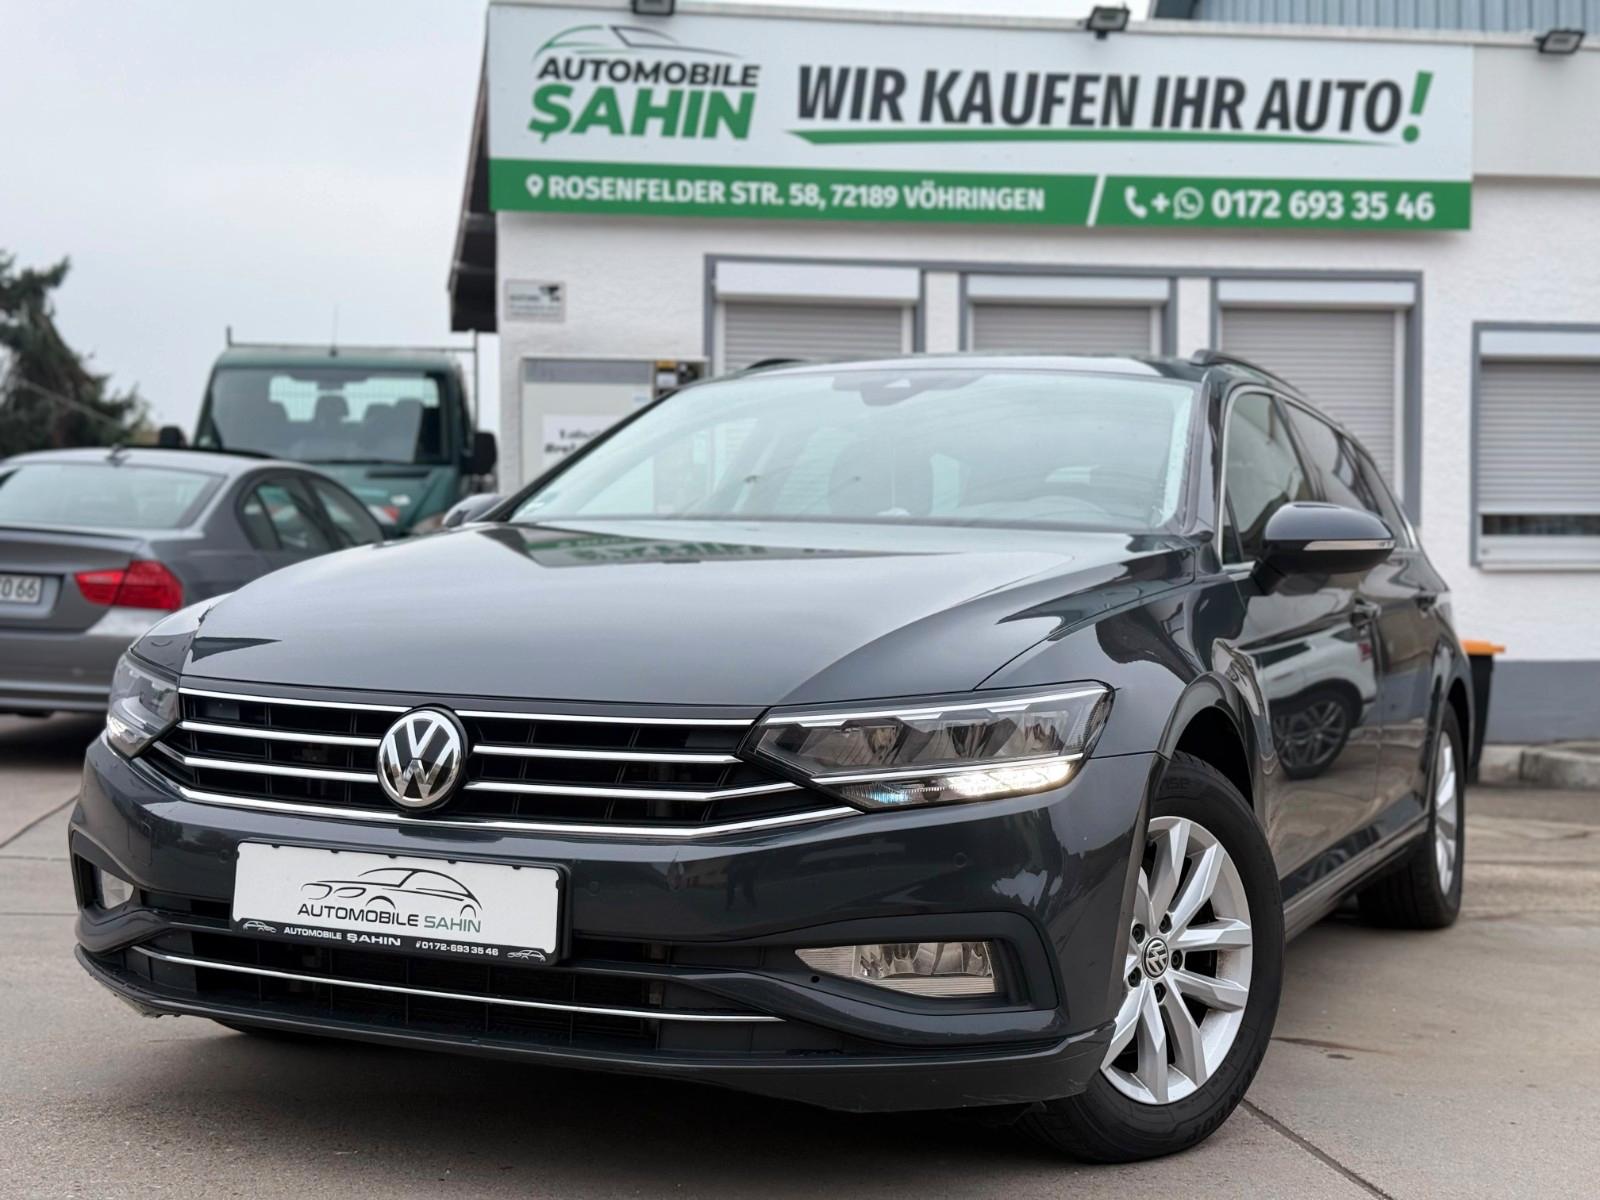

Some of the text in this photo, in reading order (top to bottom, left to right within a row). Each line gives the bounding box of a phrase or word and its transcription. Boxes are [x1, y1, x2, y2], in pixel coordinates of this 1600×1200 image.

[537, 57, 760, 88] AUTOMOBILE
[527, 83, 757, 142] ŞAHIN
[797, 65, 1433, 143] WIR KAUFEN IHR AUTO!
[548, 175, 1045, 212] ROSENFELDER STR. 58, 72189 VÖHRINGEN
[1211, 187, 1436, 221] 0172 693 35 46
[284, 926, 342, 941] AUTOMOBILE
[297, 903, 482, 933] AUTOMOBILE SAHIN
